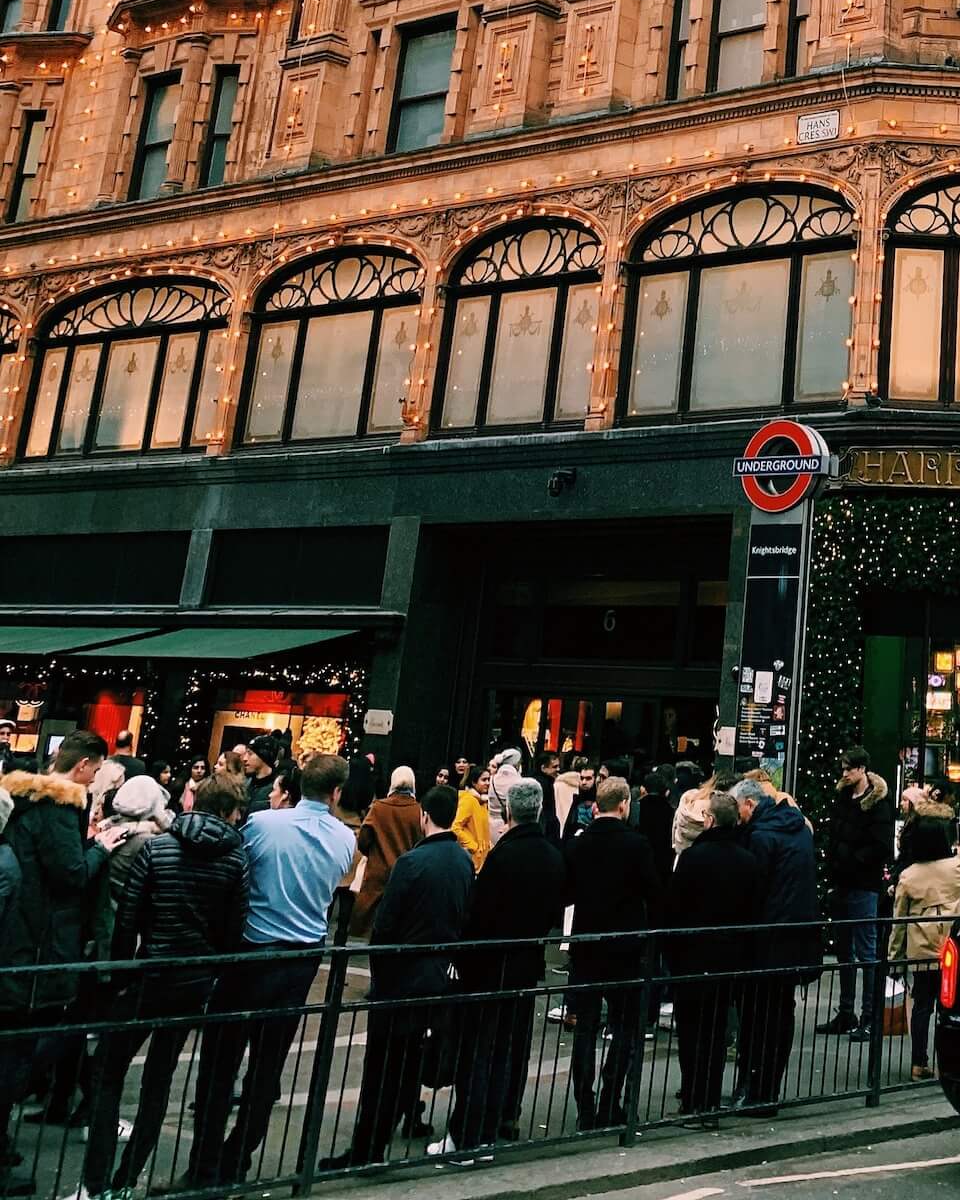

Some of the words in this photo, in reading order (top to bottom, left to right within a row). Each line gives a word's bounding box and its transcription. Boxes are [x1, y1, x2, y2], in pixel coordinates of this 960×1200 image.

[807, 118, 831, 130] HANS
[736, 458, 820, 473] UNDERGROUND
[751, 545, 798, 556] Knightsbridge
[234, 711, 265, 720] CHANEL
